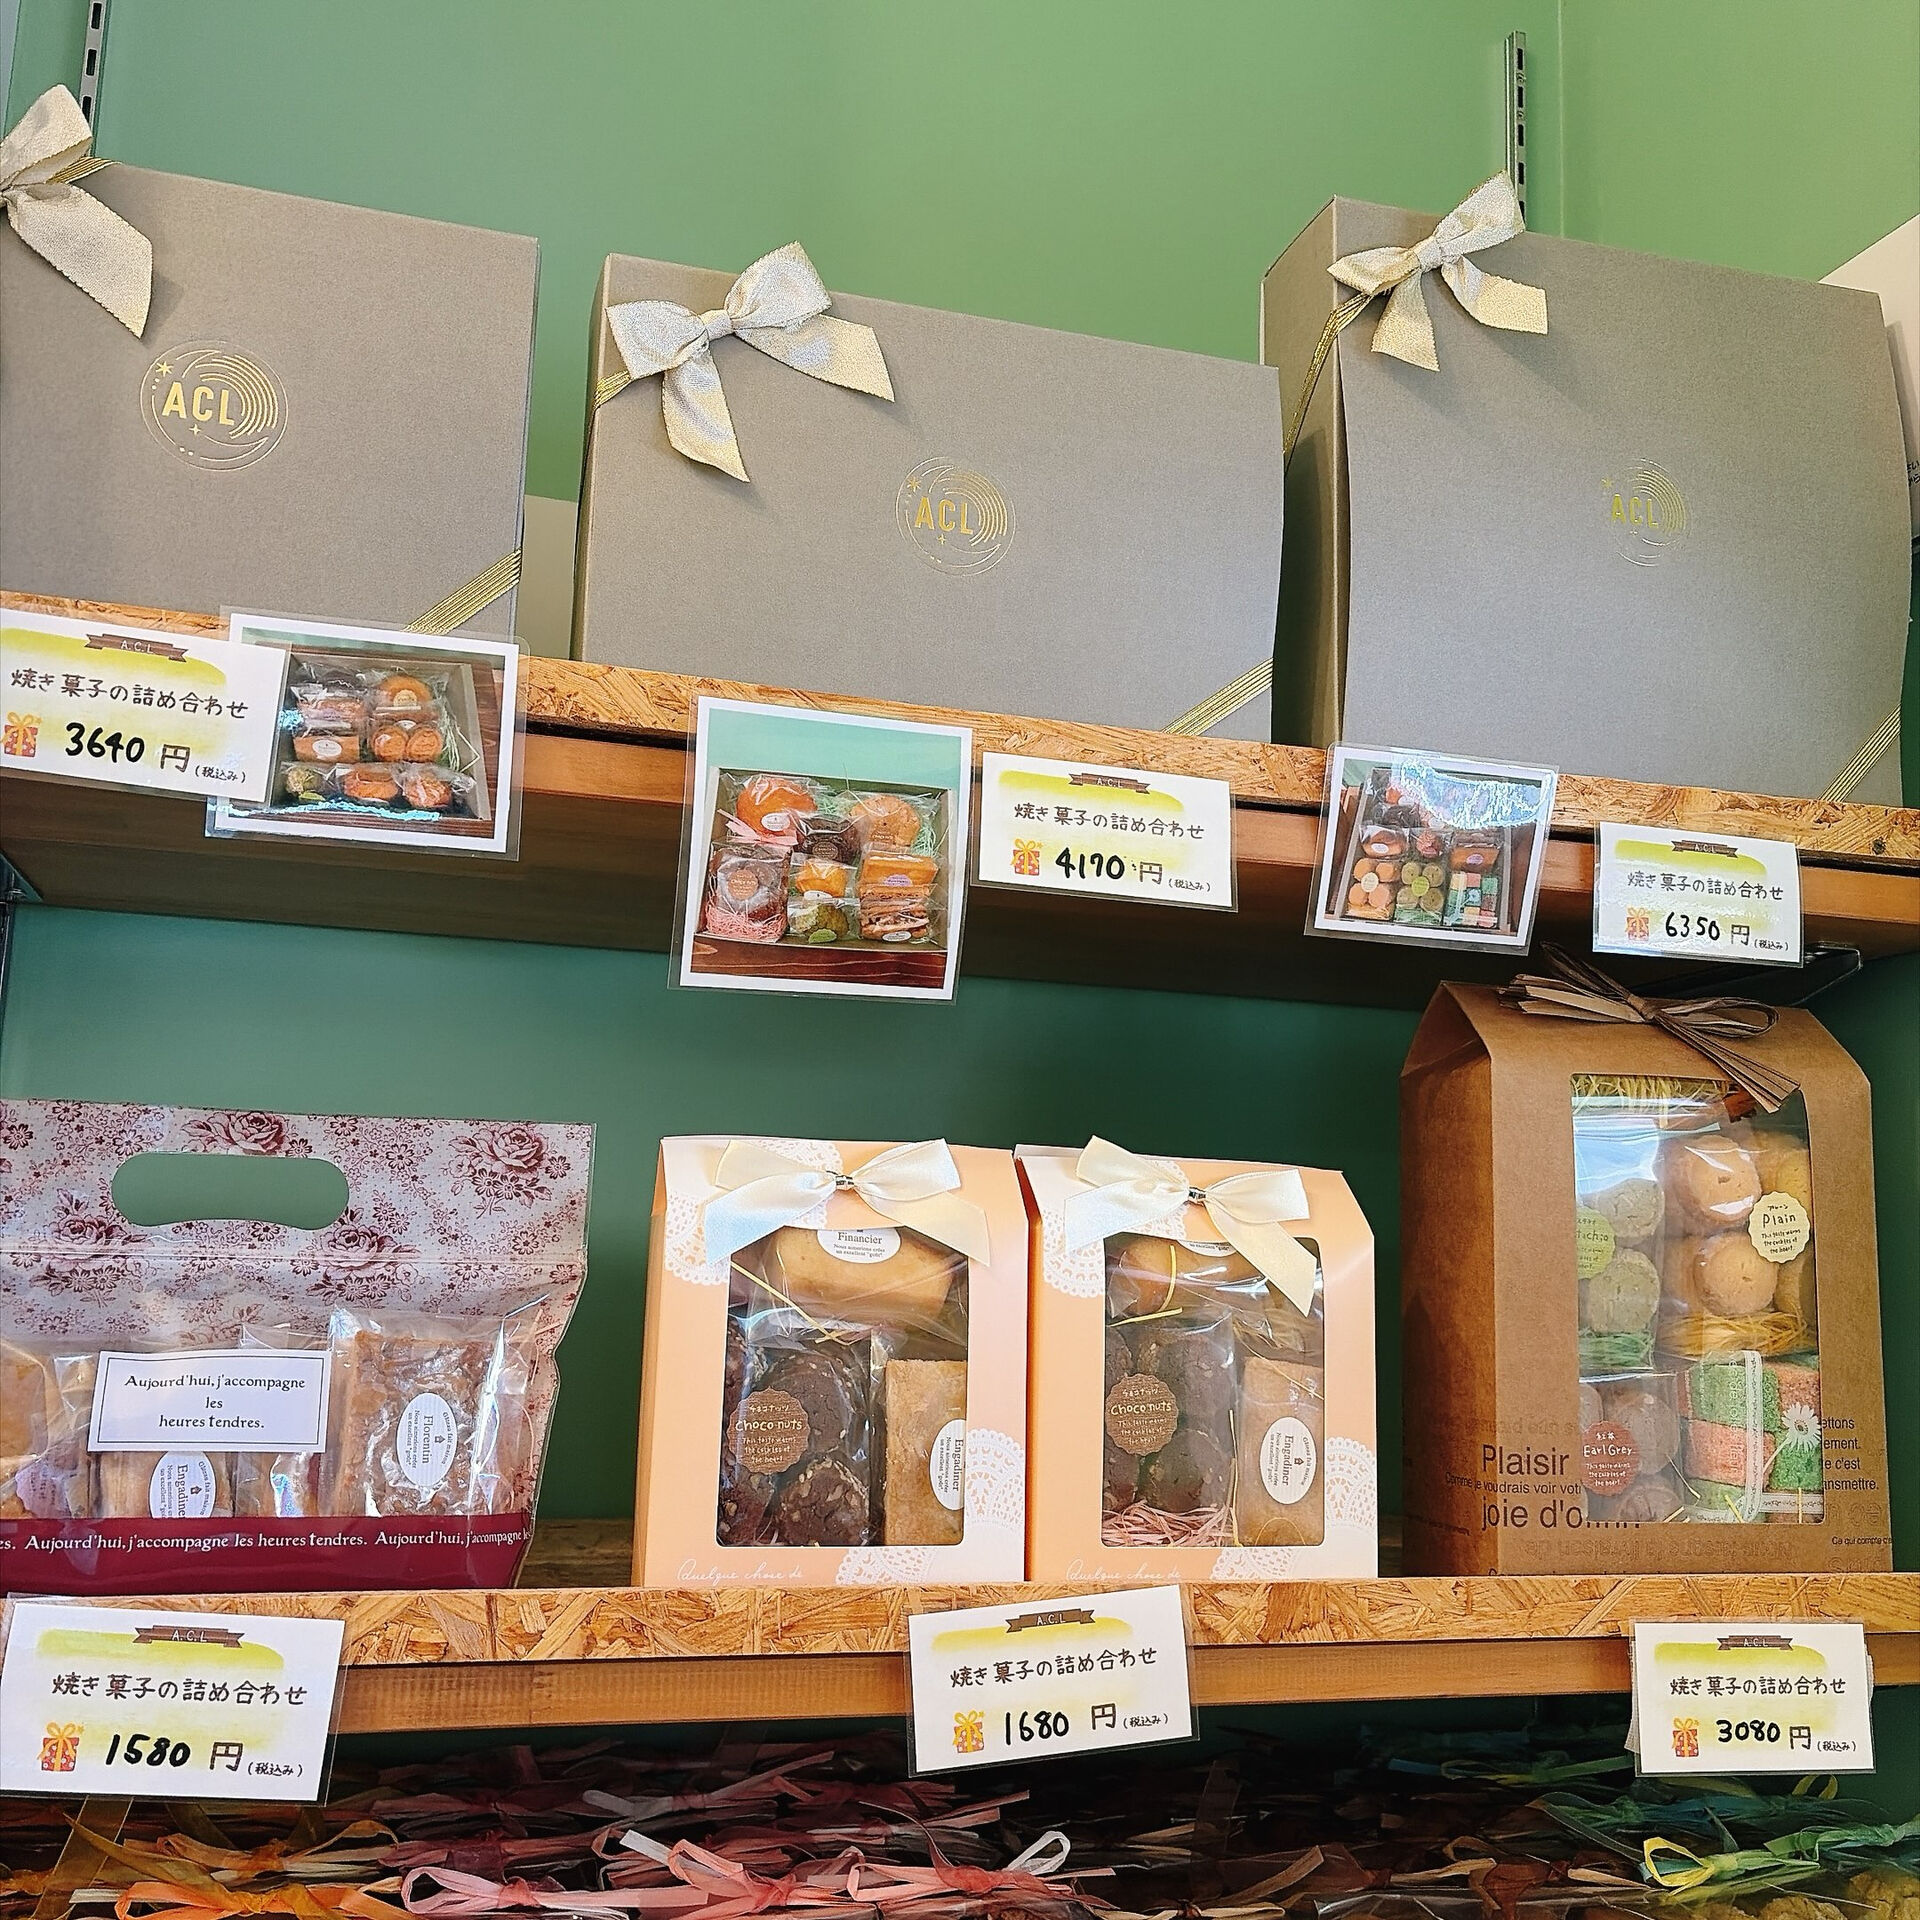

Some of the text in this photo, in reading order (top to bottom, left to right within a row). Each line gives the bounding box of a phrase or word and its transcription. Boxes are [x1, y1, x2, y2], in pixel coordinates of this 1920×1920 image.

[161, 381, 235, 426] ACL
[914, 496, 974, 535] ACL
[1610, 493, 1659, 529] ACL
[11, 667, 249, 719] 焼き菓子の詰め合わせ
[65, 722, 146, 764] 3640
[1014, 802, 1206, 840] 焼き菓子の詰め合わせ
[1055, 847, 1126, 880] 4170
[1627, 870, 1784, 901] 焼き菓子の詰め合わせ
[1665, 911, 1721, 941] 6350
[1763, 1213, 1796, 1229] Plain
[837, 1231, 883, 1245] Financier
[124, 1373, 306, 1391] Aujourd'hui, j'accompagne
[205, 1396, 223, 1409] les
[1149, 1400, 1172, 1412] nuts
[158, 1414, 266, 1430] heures tendres.
[778, 1418, 803, 1431] nuts
[422, 1415, 434, 1464] Florentin
[1583, 1444, 1633, 1458] Earl Grey
[1481, 1444, 1570, 1476] Plaisir
[1835, 1457, 1861, 1470] c'est
[175, 1464, 188, 1518] Engadine
[1484, 1480, 1530, 1494] voudrais
[1534, 1481, 1556, 1494] voir
[1481, 1496, 1529, 1531] joie
[24, 1535, 127, 1554] Aujourd'hui,
[127, 1533, 229, 1553] j'accompagne
[234, 1533, 254, 1547] les
[258, 1533, 306, 1547] heures
[309, 1531, 368, 1547] tendres.
[374, 1531, 465, 1550] Aujourd'hui,
[464, 1529, 522, 1549] j'accompagne
[677, 1558, 804, 1586] Quelque chose de
[1126, 1562, 1162, 1580] chose
[1167, 1565, 1181, 1579] de
[950, 1647, 1158, 1689] 焼き菓子の詰め合わせ
[52, 1671, 308, 1707] 焼き菓子の詰め合わせ
[1669, 1675, 1847, 1698] 焼き菓子の詰め合わせ
[1005, 1711, 1070, 1746] 1680
[1715, 1719, 1781, 1744] 3080
[105, 1733, 192, 1768] 1580
